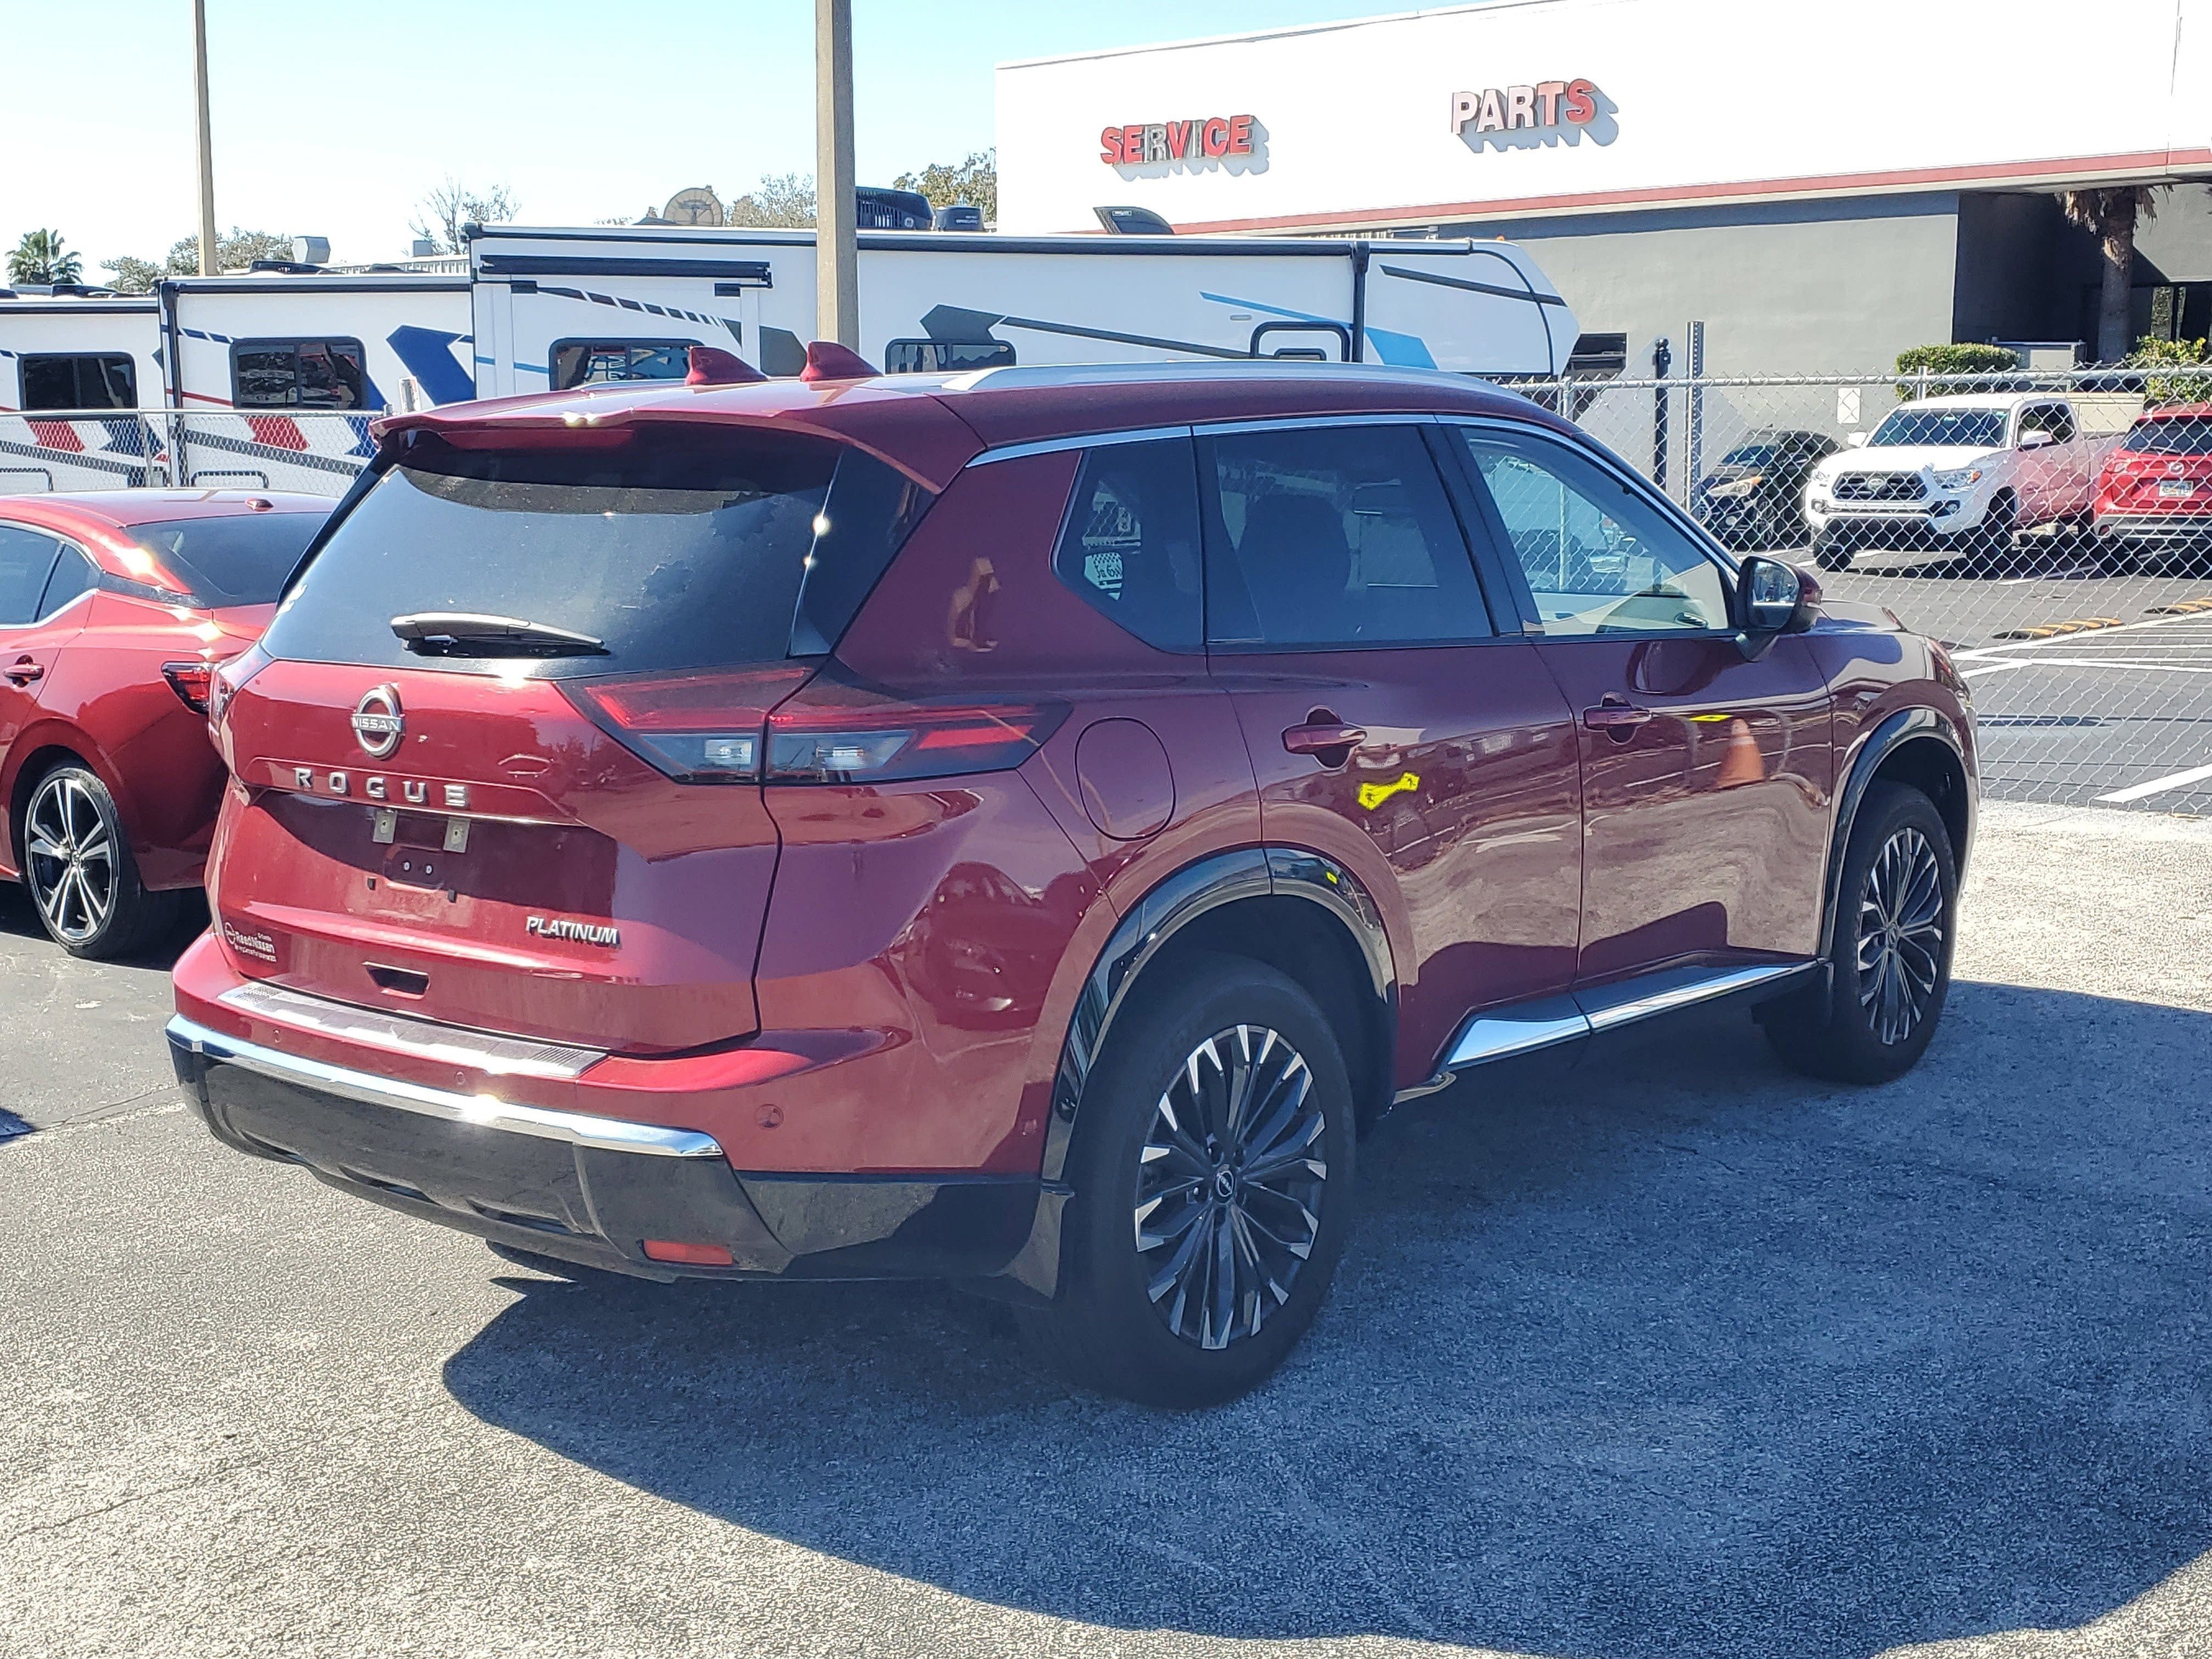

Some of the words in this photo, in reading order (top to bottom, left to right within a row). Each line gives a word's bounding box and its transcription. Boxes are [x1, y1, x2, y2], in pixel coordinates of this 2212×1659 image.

[1452, 78, 1595, 134] PARTS
[1101, 115, 1254, 165] SERVICE
[351, 718, 400, 730] NISSAN
[292, 768, 467, 807] ROGUE
[525, 916, 619, 945] PLATINUM
